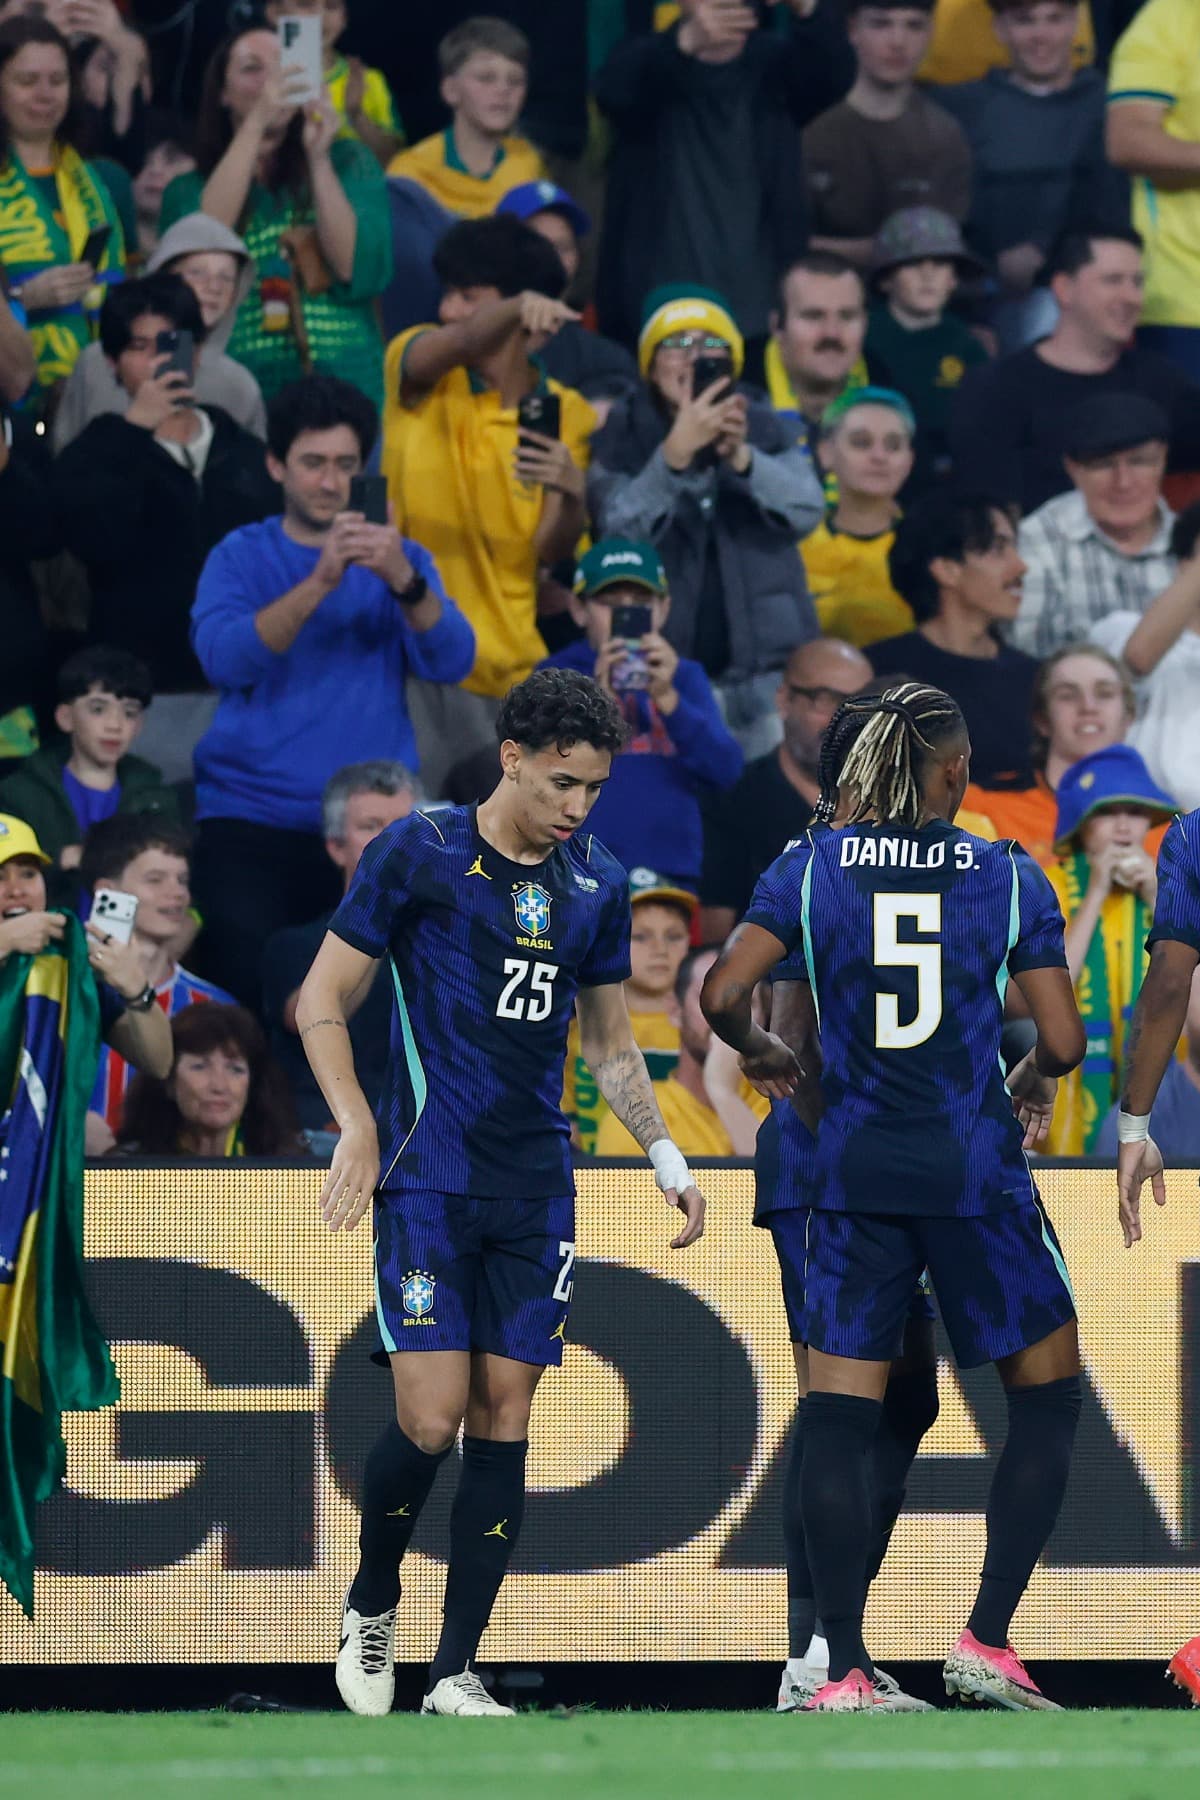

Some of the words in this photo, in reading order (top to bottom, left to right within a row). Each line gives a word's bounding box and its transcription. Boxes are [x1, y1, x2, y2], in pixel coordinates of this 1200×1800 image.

[839, 836, 946, 869] DANILO
[954, 842, 981, 871] S.
[515, 936, 554, 950] BRASIL
[496, 957, 560, 1023] 25
[873, 892, 943, 1050] 5
[552, 1240, 576, 1303] 2
[403, 1316, 438, 1327] BRASIL
